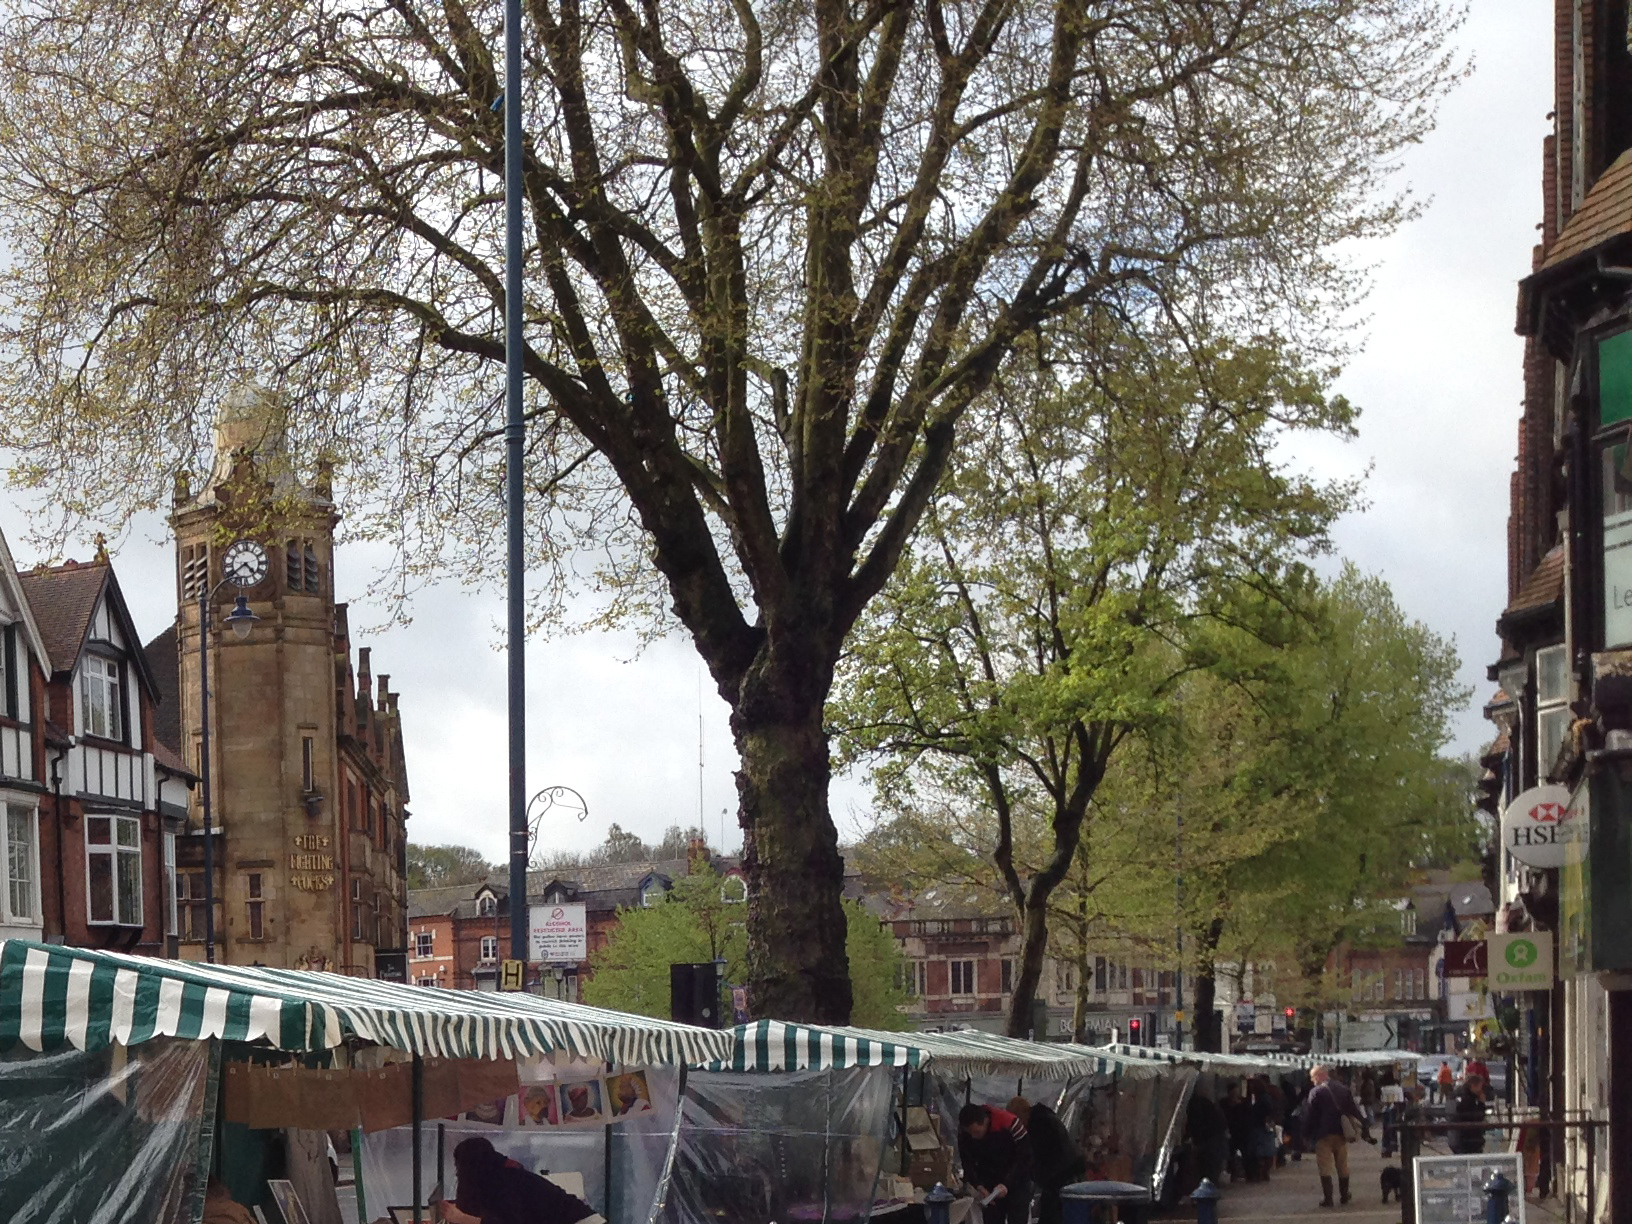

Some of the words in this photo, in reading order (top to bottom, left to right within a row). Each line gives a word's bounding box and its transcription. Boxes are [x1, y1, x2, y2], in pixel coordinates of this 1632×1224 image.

[303, 834, 321, 849] THE
[1511, 823, 1586, 847] HSB
[504, 963, 520, 986] H
[1496, 971, 1547, 984] Oxfam
